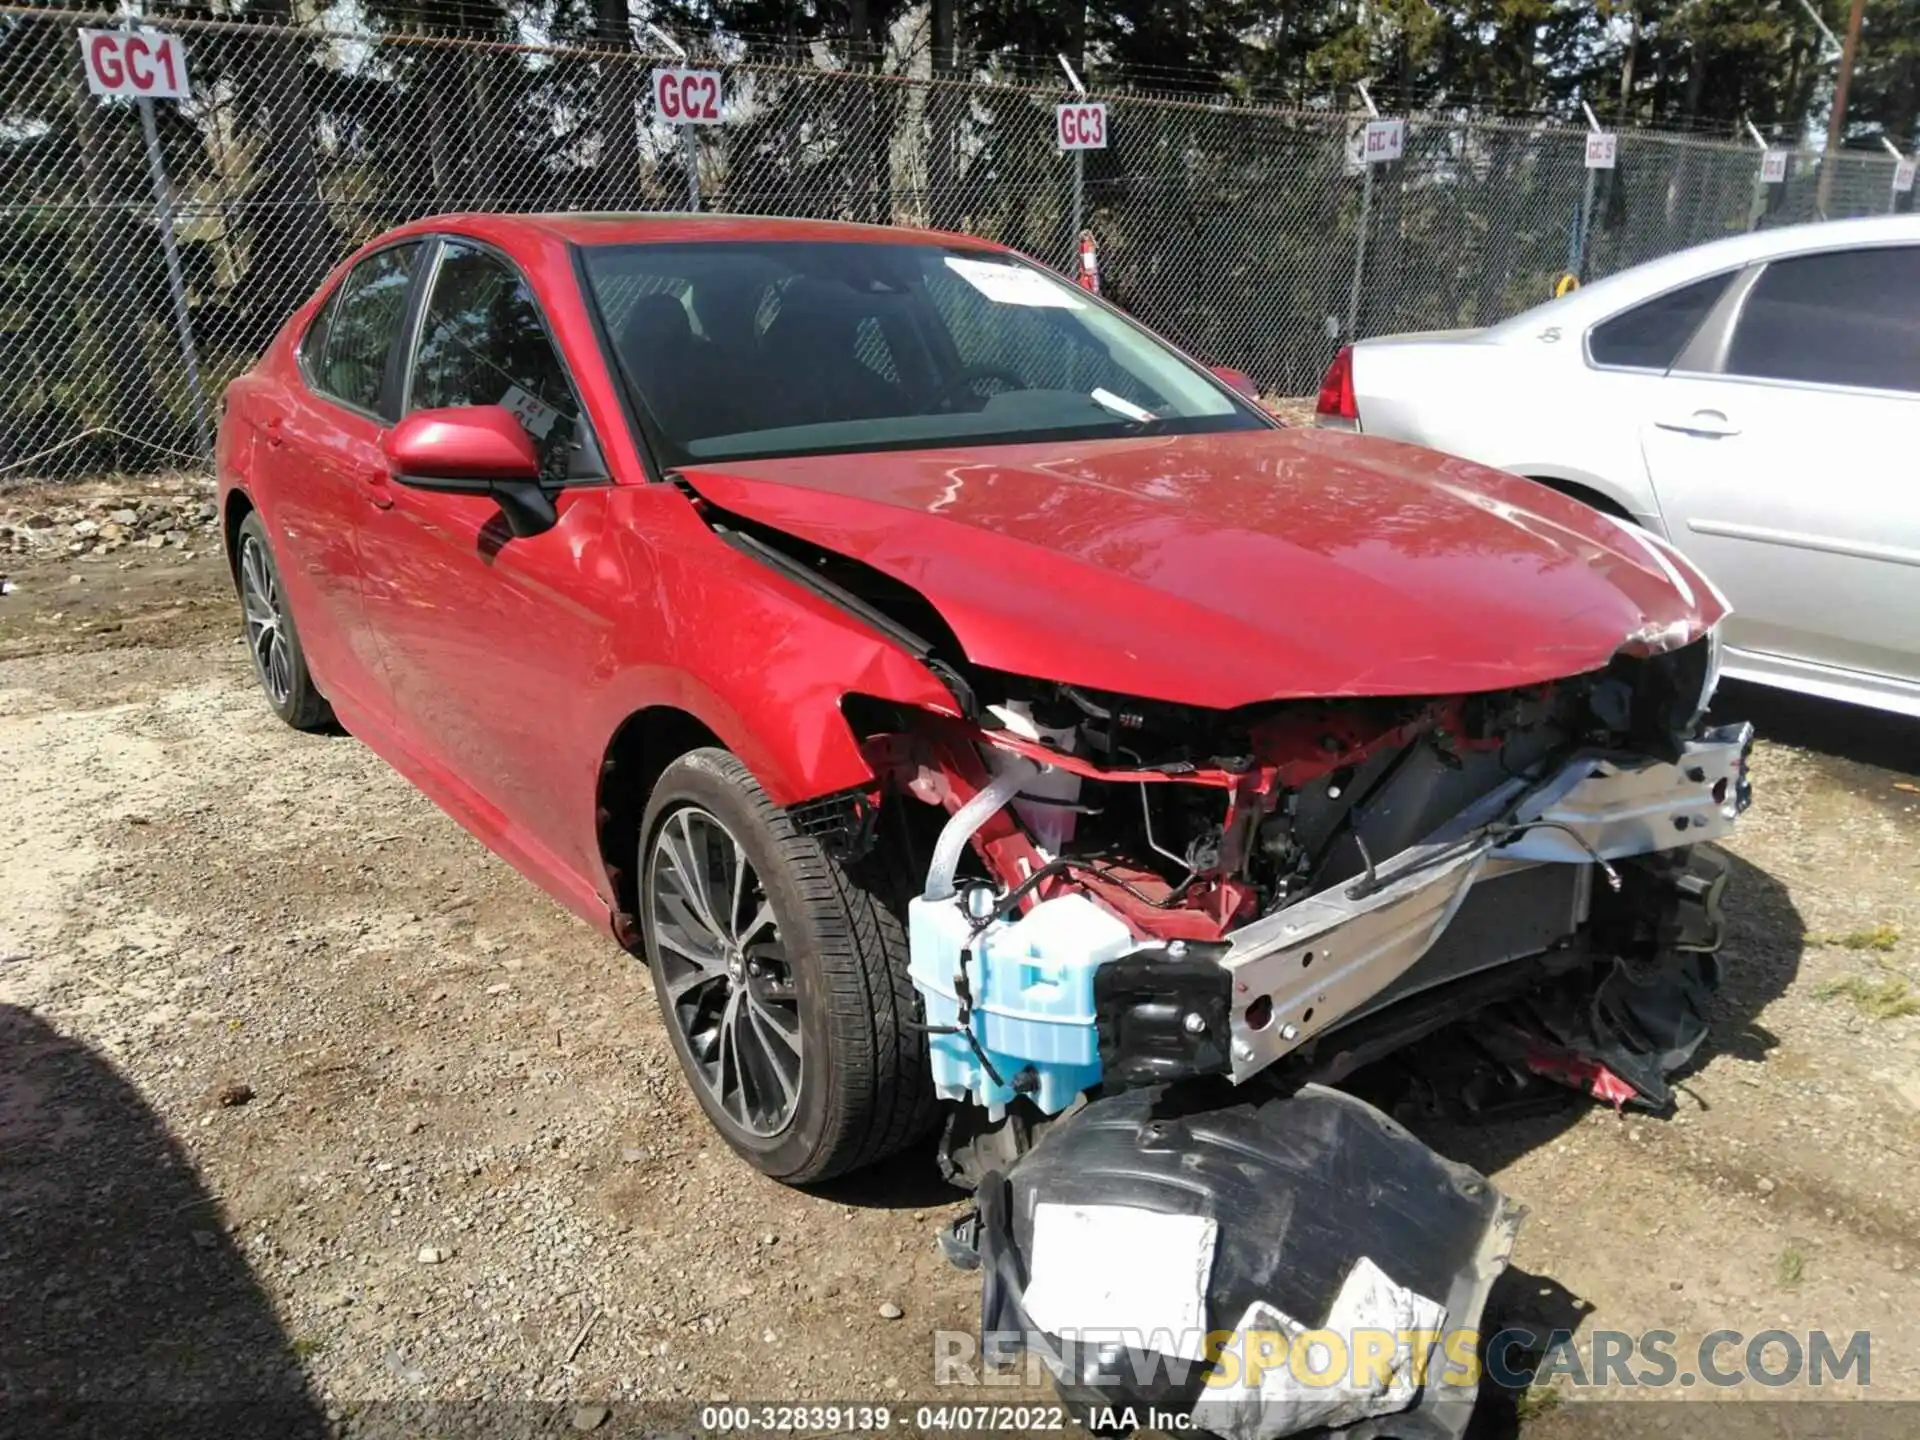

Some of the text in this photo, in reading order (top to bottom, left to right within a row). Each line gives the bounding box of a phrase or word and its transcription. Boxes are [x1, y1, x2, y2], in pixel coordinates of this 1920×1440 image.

[92, 35, 177, 91] GC1
[660, 74, 718, 119] GC2
[1061, 108, 1102, 145] GC3
